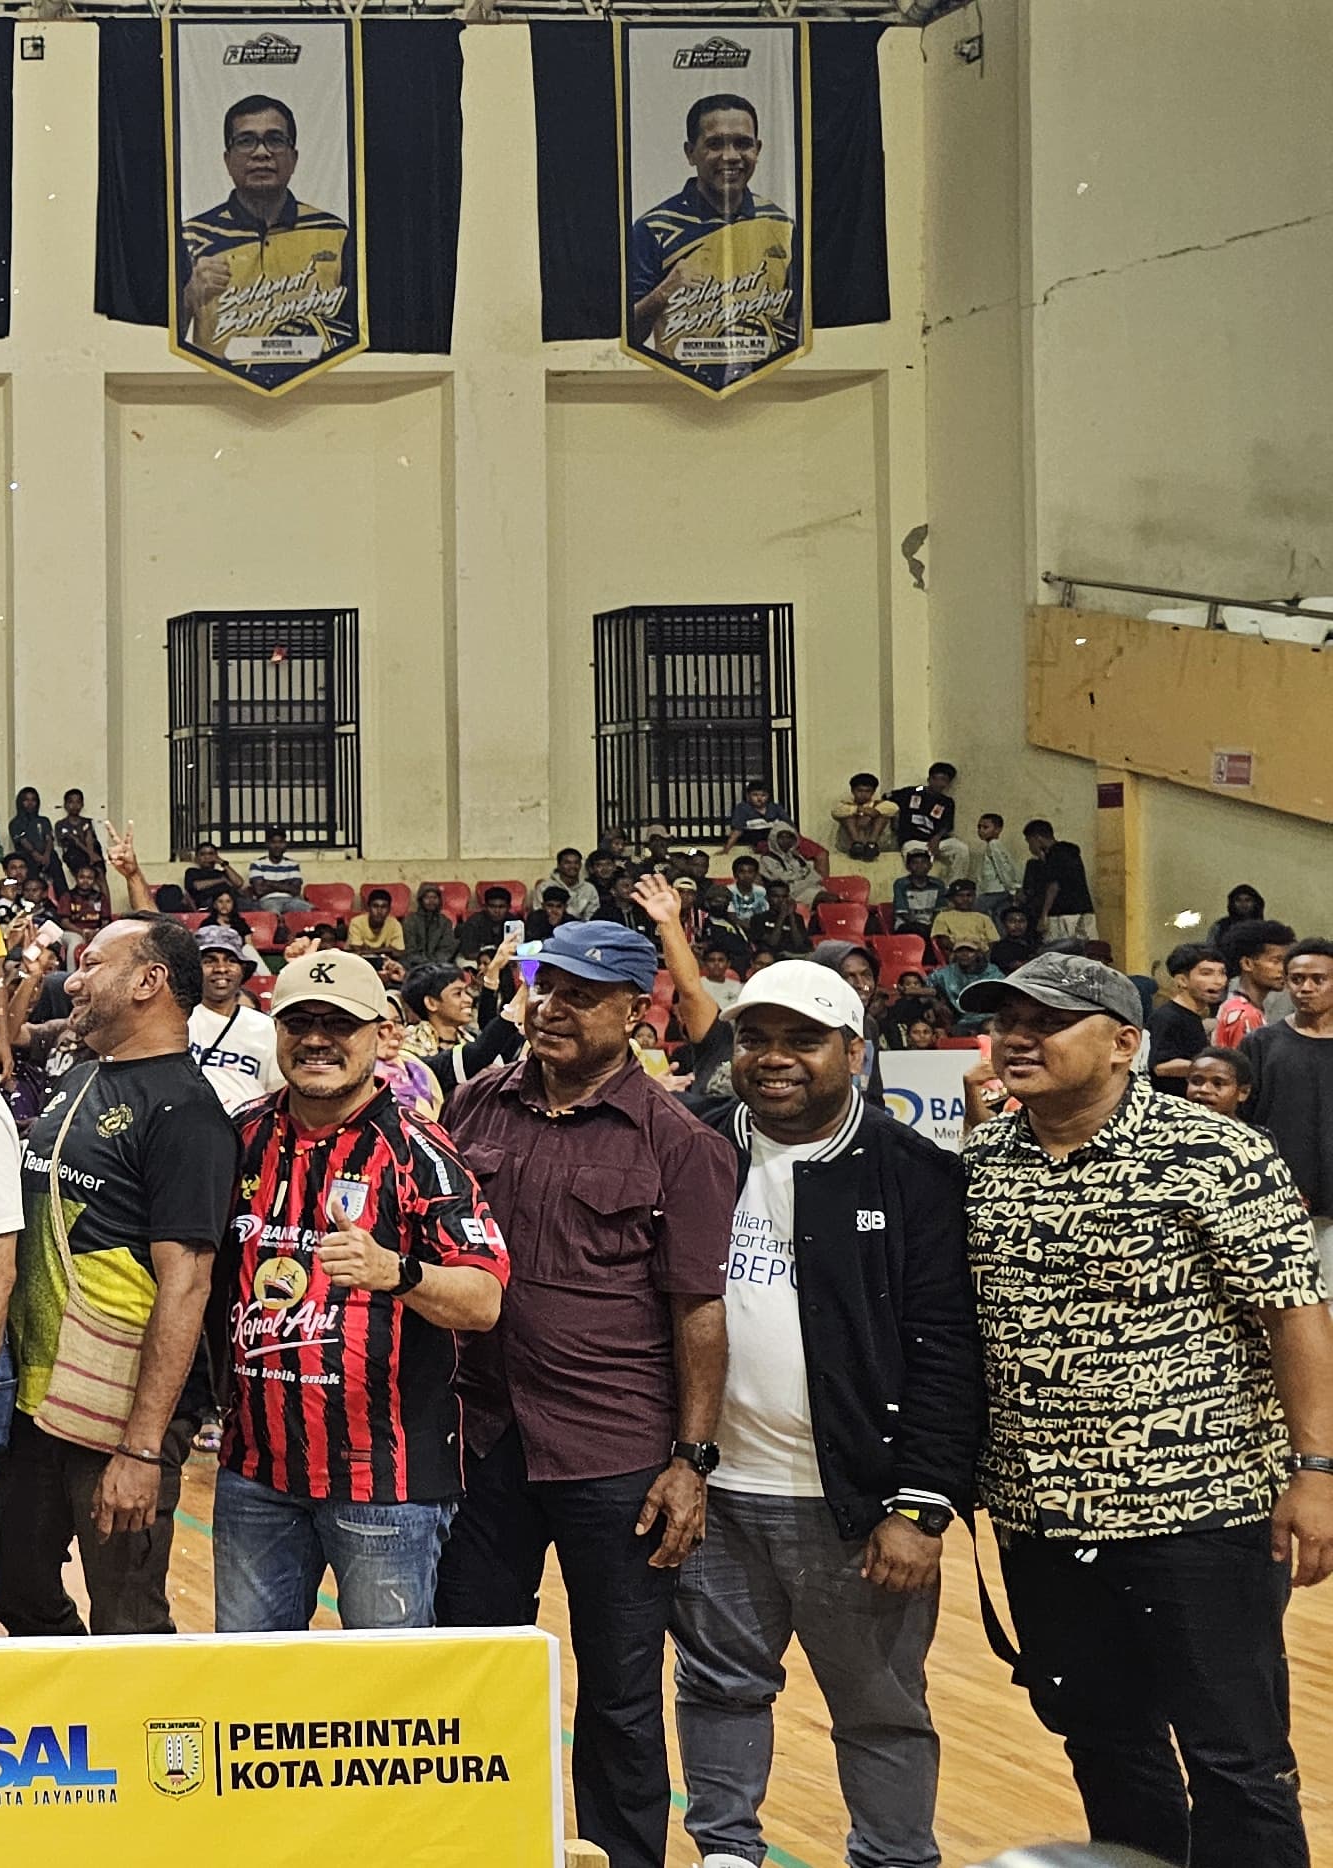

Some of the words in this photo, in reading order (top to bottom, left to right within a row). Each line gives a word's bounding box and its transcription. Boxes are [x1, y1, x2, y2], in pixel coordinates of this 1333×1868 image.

[219, 261, 318, 308] Selamat
[665, 261, 768, 311] Selamat
[211, 285, 348, 342] Bertanding
[664, 287, 791, 342] Bertanding
[930, 1098, 965, 1121] BA
[261, 1224, 302, 1242] BANK
[231, 1301, 286, 1350] Kapal
[283, 1300, 339, 1340] Api
[1066, 1327, 1115, 1346] 1996
[1071, 1357, 1190, 1389] 3SECOND
[1190, 1348, 1223, 1365] EST
[1076, 1343, 1186, 1367] AUTHENTIC
[262, 1365, 296, 1382] lebih
[300, 1373, 340, 1386] enak
[1038, 1386, 1114, 1399] STRENGTH
[1117, 1366, 1218, 1402] GROWTH
[1037, 1395, 1163, 1412] TRADEMARK
[1165, 1382, 1240, 1406] SIGNATURE
[1073, 1415, 1112, 1430] 1996
[1106, 1397, 1227, 1448] GRIT
[1143, 1435, 1246, 1463] AUTHENTIC
[1080, 1471, 1132, 1488] 1996
[1091, 1500, 1215, 1529] 3SECOND
[1214, 1494, 1249, 1511] EST
[1098, 1487, 1208, 1508] AUTHENTIC
[230, 1718, 461, 1752] PEMERINTAH
[231, 1760, 322, 1790] KOTA
[330, 1754, 510, 1789] JAYAPURA
[33, 1787, 119, 1806] JAYAPURA
